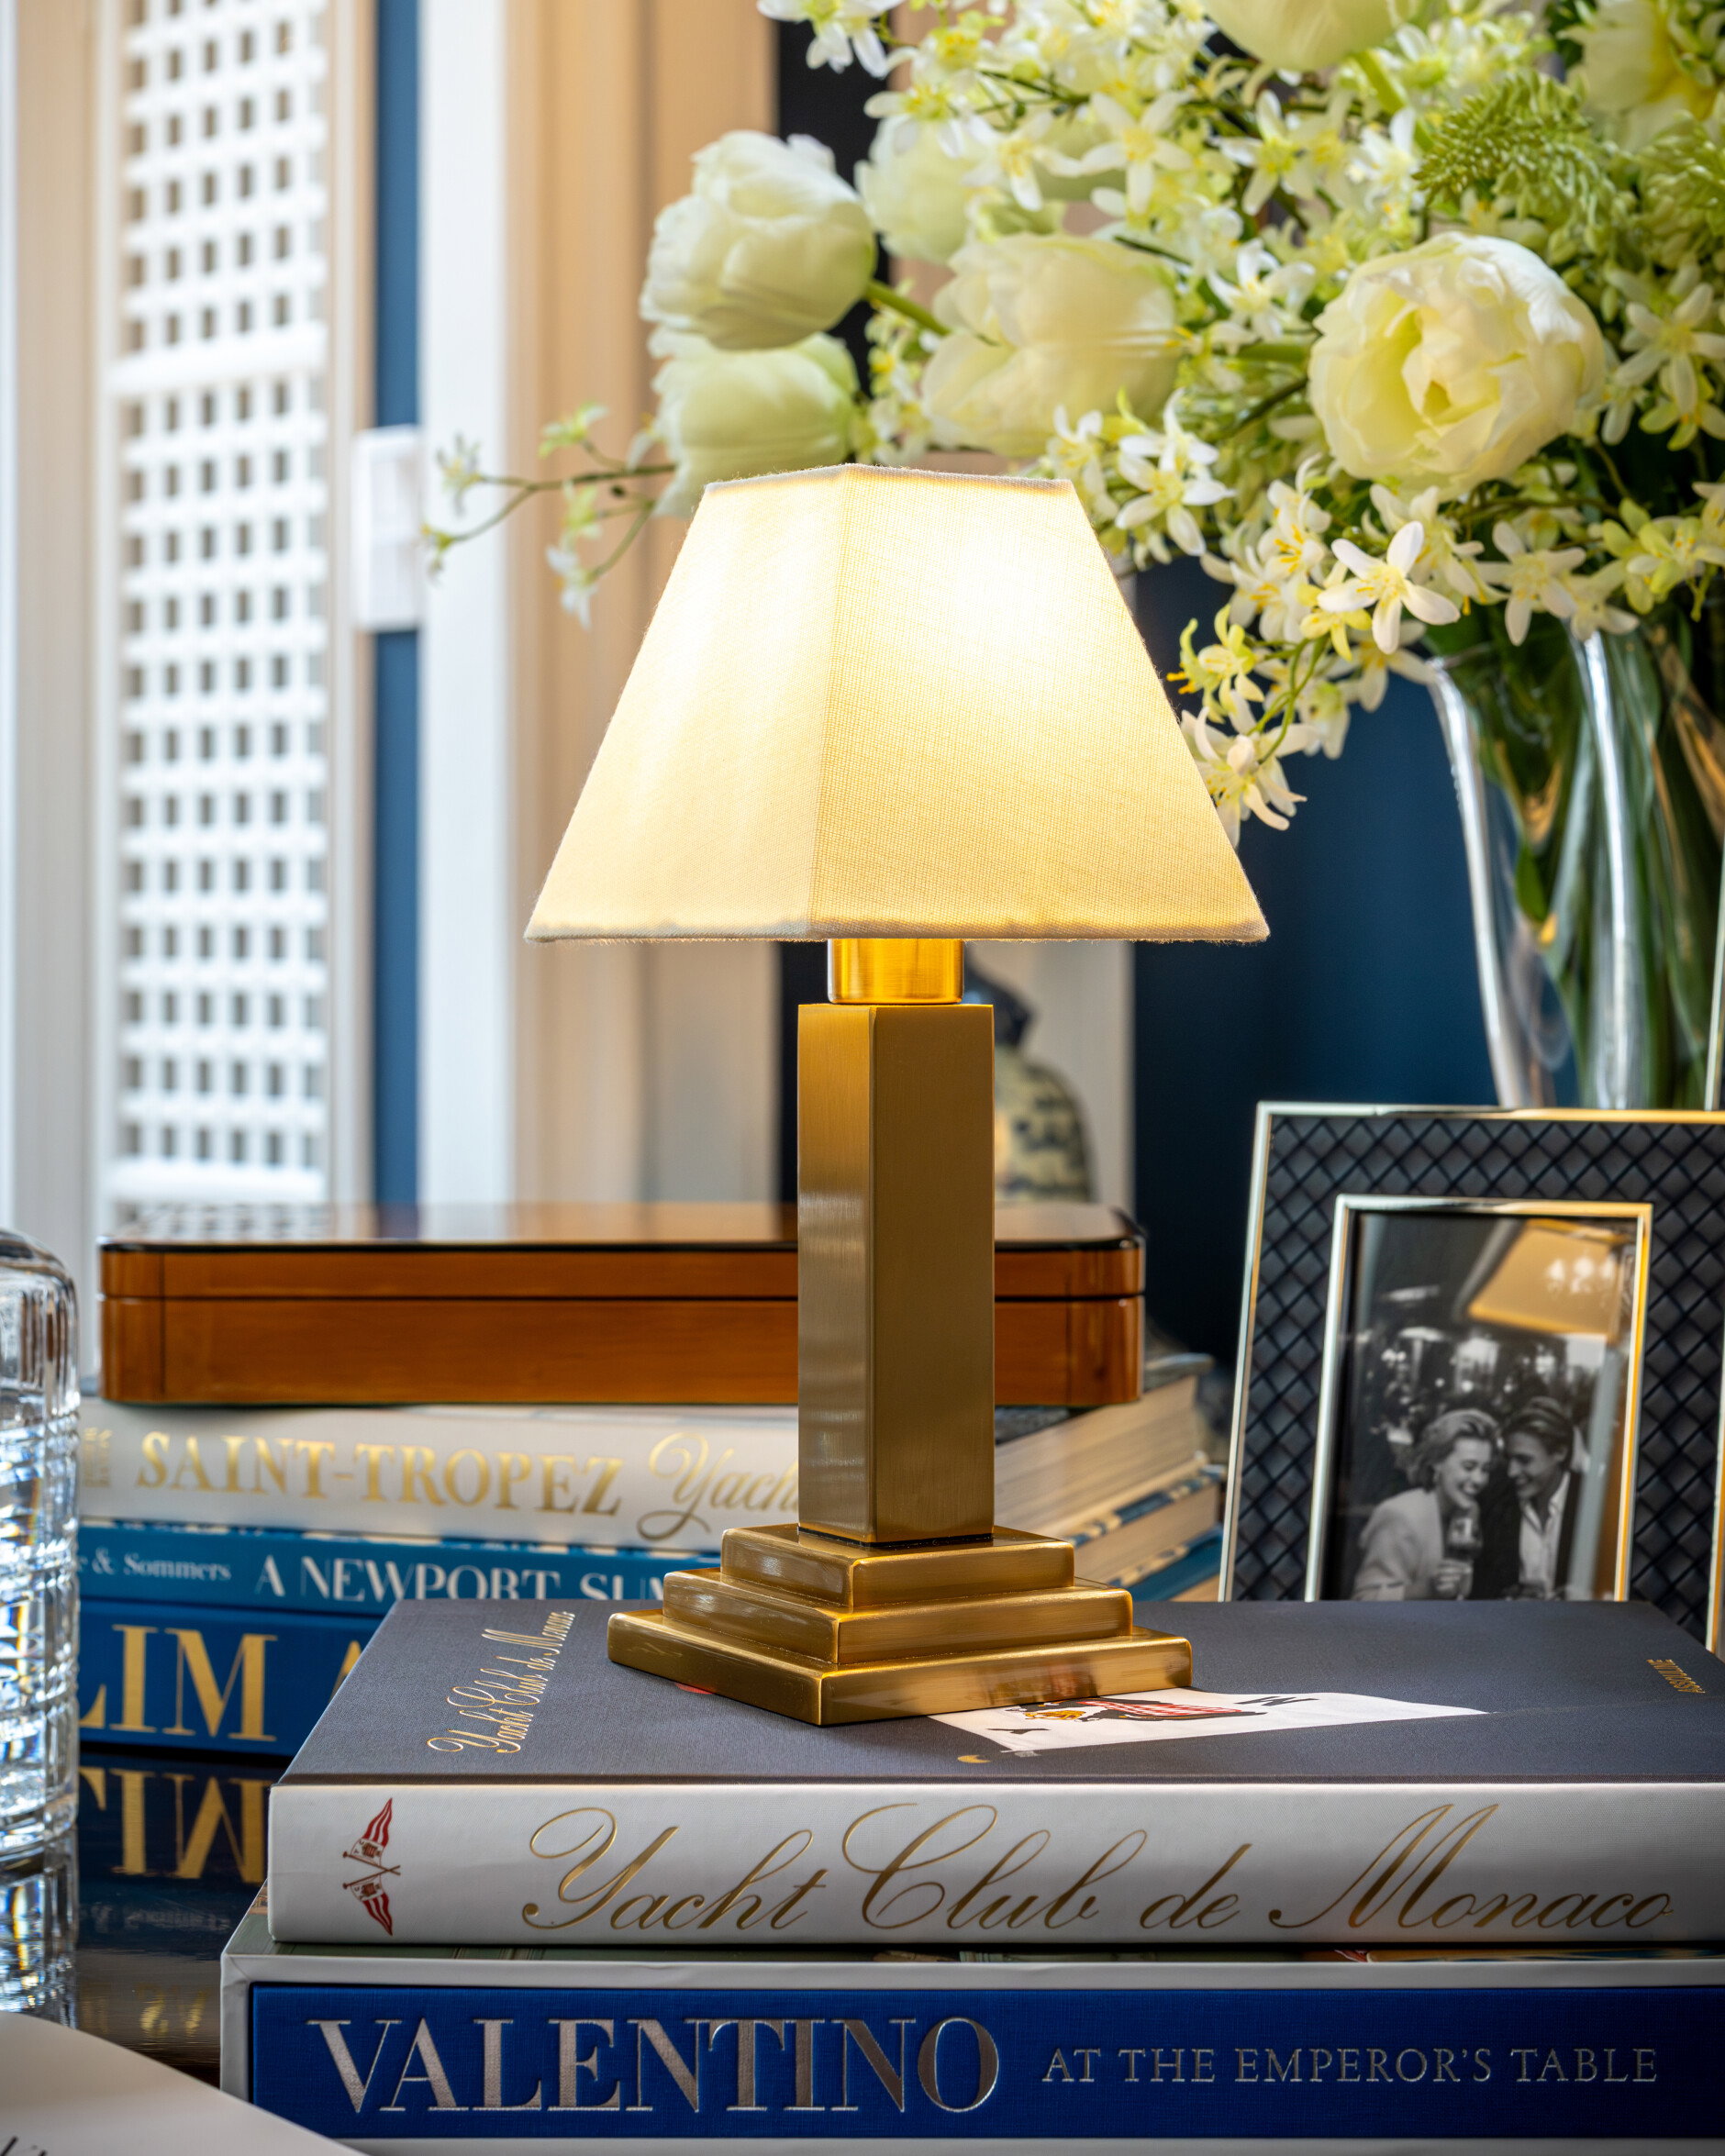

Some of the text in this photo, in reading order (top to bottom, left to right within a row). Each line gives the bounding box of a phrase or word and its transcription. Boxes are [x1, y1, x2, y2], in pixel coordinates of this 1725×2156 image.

[135, 1430, 624, 1517] SAINT-TROPEZ
[92, 1547, 116, 1574] &
[123, 1552, 231, 1581] Sommers
[254, 1554, 286, 1597] A
[300, 1556, 561, 1602] NEWPORT
[493, 1654, 557, 1671] de
[446, 1667, 549, 1708] Club
[426, 1707, 534, 1754] Yacht
[522, 1802, 1675, 1930] Yacht Club de Monaco
[306, 2017, 1658, 2113] VALENTINO AT THE EMPEROR'S TABLE
